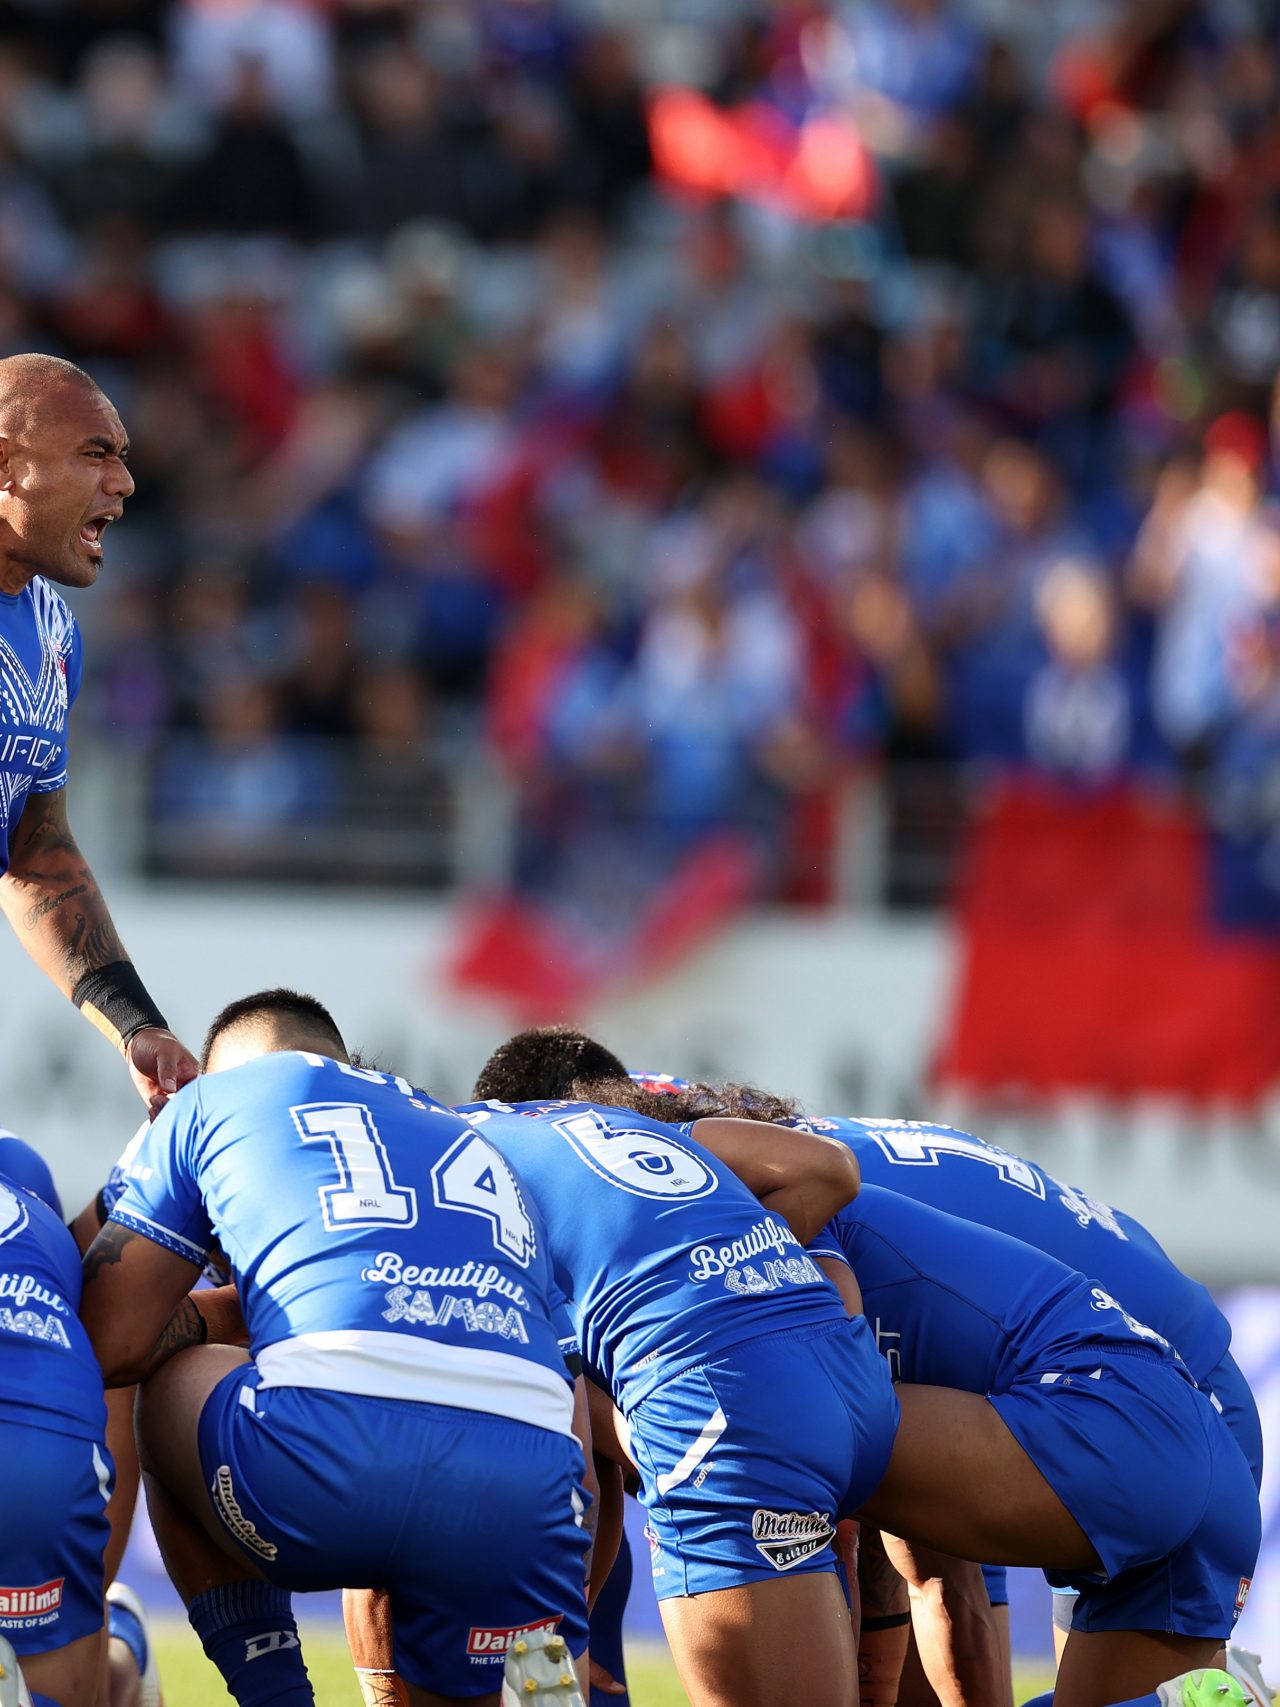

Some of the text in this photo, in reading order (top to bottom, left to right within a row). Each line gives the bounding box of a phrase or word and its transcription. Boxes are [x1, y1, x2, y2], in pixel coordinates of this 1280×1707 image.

[551, 1108, 719, 1201] 6
[289, 1102, 536, 1269] 14
[359, 1199, 382, 1208] NRL
[361, 1252, 530, 1312] Beautiful
[380, 1285, 530, 1344] SAMOA
[25, 1618, 37, 1627] OF
[470, 1656, 505, 1664] THE TAS
